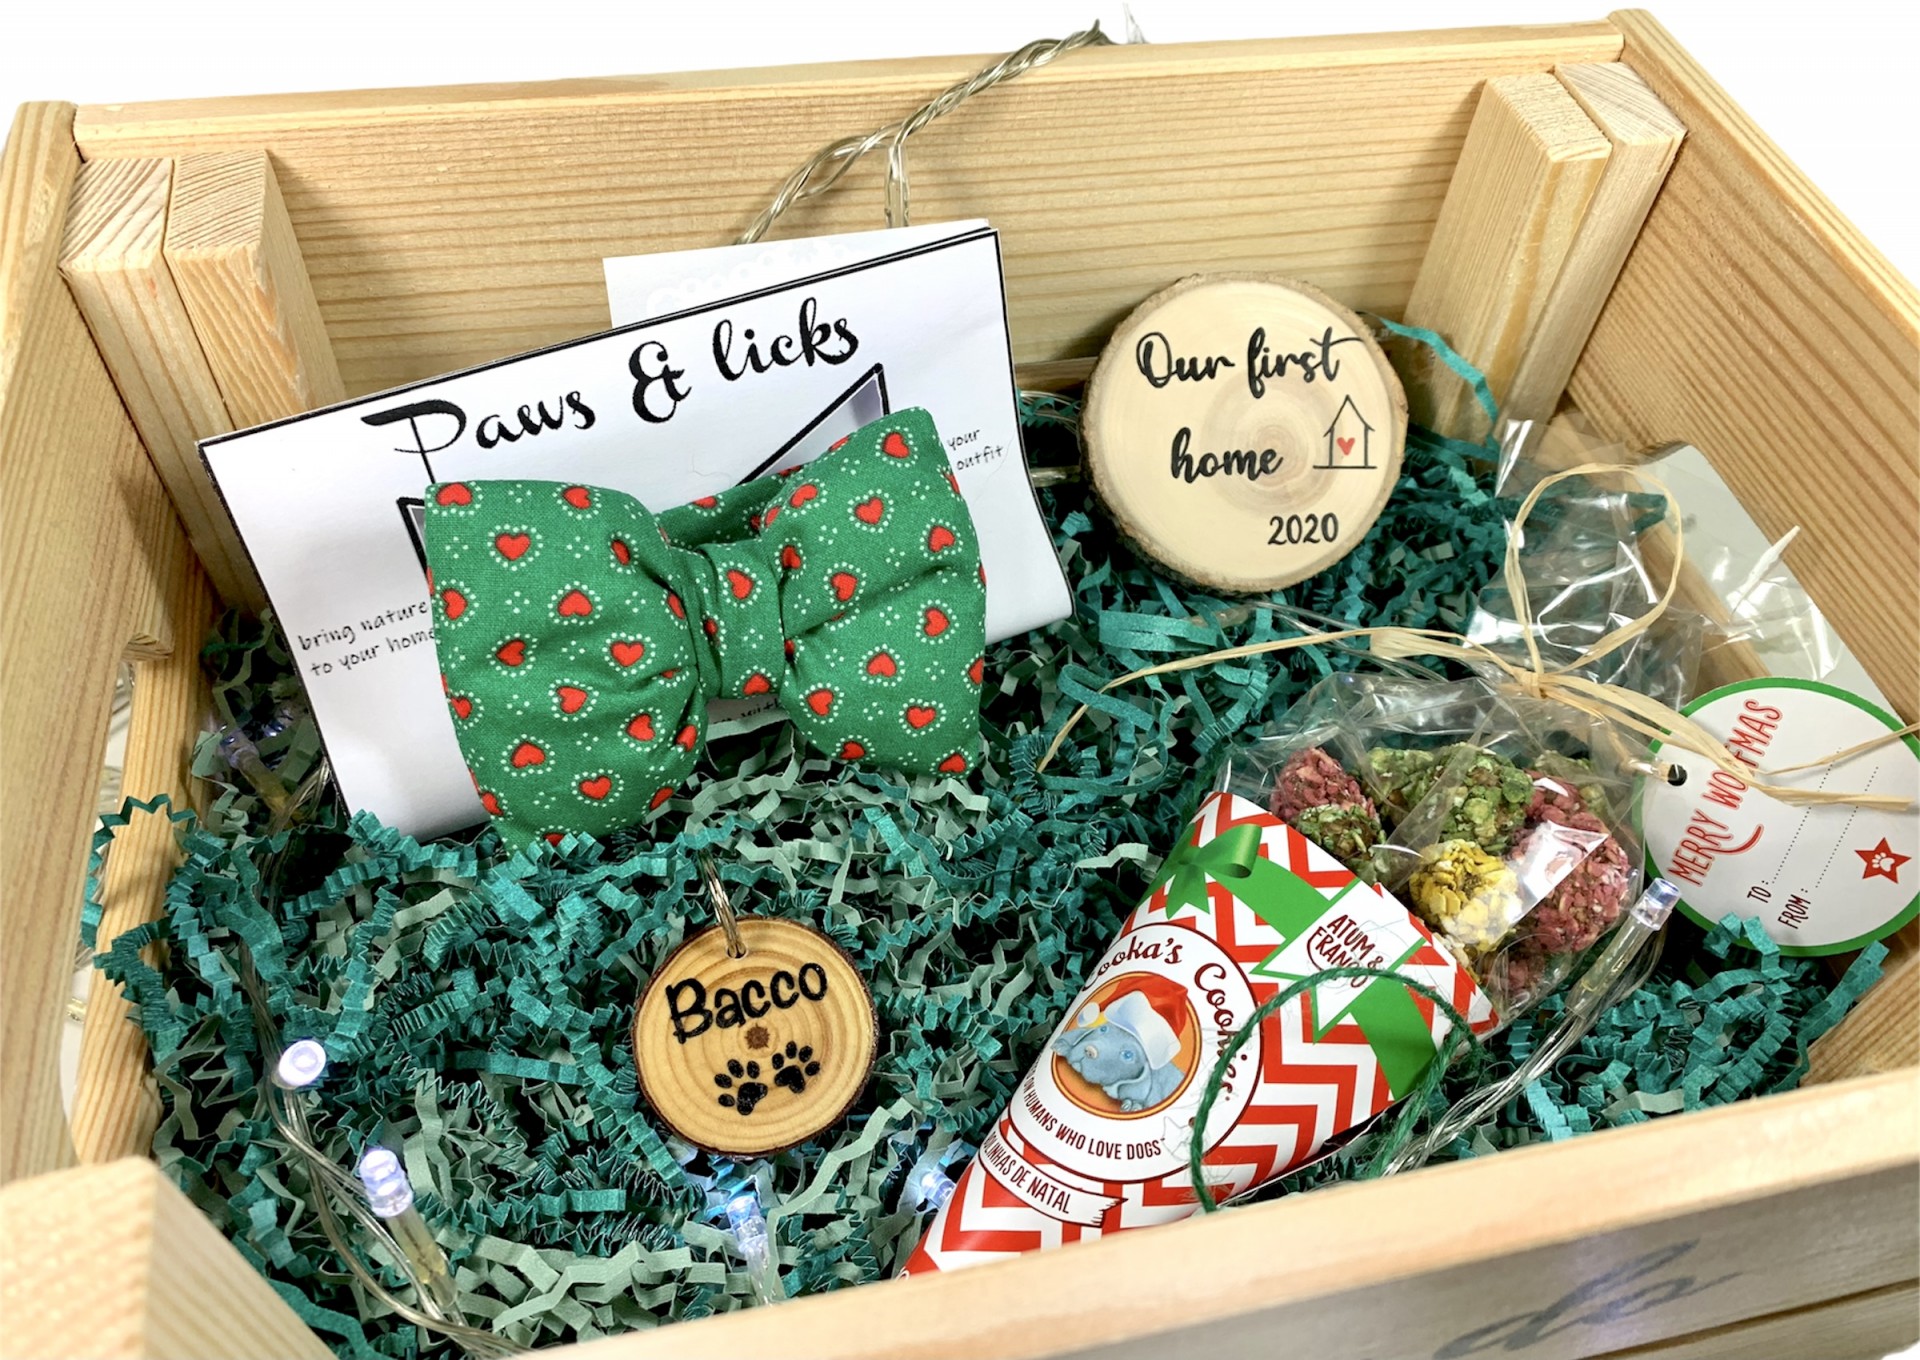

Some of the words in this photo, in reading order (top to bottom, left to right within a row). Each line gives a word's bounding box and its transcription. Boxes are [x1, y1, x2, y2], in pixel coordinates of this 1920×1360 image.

[1136, 331, 1235, 389] Our
[1247, 326, 1364, 399] first
[360, 390, 596, 484] Paws
[629, 340, 692, 424] &
[712, 296, 859, 382] licks
[947, 428, 980, 451] your
[956, 445, 1004, 471] outfit
[1170, 426, 1284, 484] home
[1266, 511, 1340, 546] 2020
[297, 625, 356, 650] bring
[360, 601, 428, 632] nature
[310, 661, 333, 676] to
[338, 643, 380, 670] your
[1701, 698, 1783, 811] WOFMAS
[1666, 809, 1764, 888] MERRY
[1326, 914, 1376, 961] ATUM
[665, 962, 828, 1045] Bacco
[1024, 1089, 1058, 1133] HUMANS
[1055, 1123, 1086, 1151] WHO
[1087, 1138, 1122, 1161] LOVE
[1010, 1164, 1032, 1189] DE
[1026, 1175, 1072, 1215] NATAL
